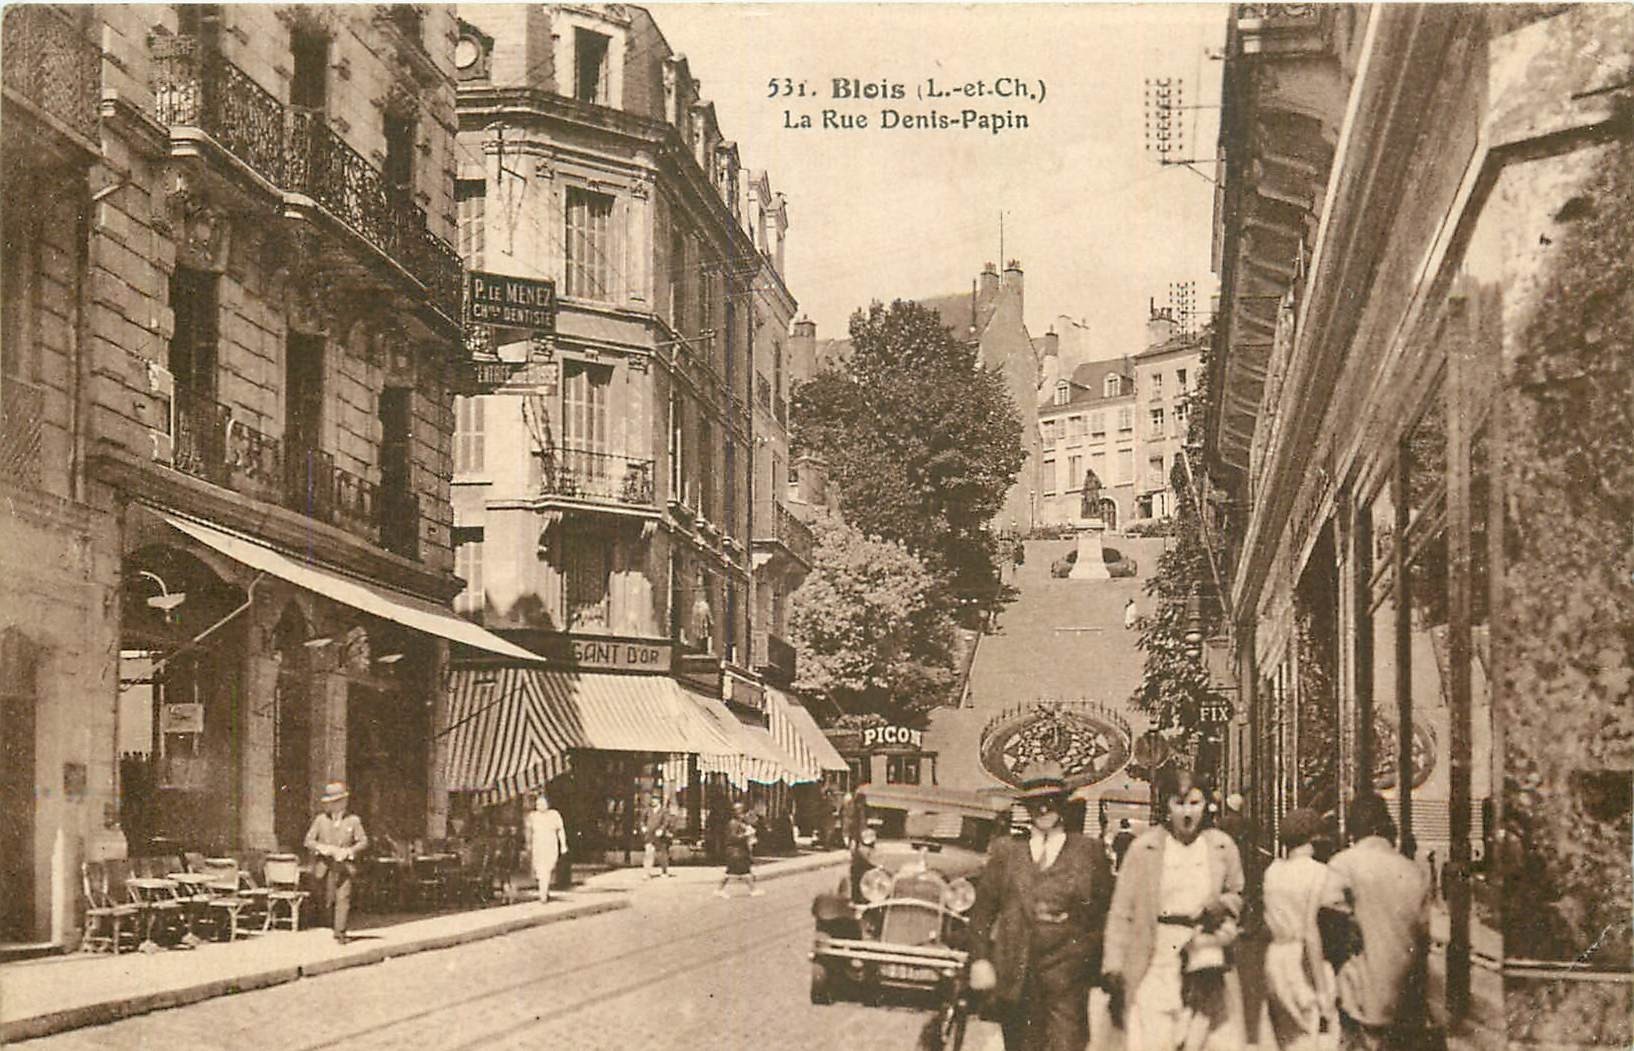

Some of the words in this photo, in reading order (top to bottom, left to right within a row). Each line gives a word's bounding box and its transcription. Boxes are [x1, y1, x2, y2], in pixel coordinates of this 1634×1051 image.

[475, 279, 487, 299] P.
[489, 286, 502, 301] LE
[504, 307, 552, 327] DENTISTE
[1200, 707, 1229, 721] FIX
[864, 726, 922, 748] PICON
